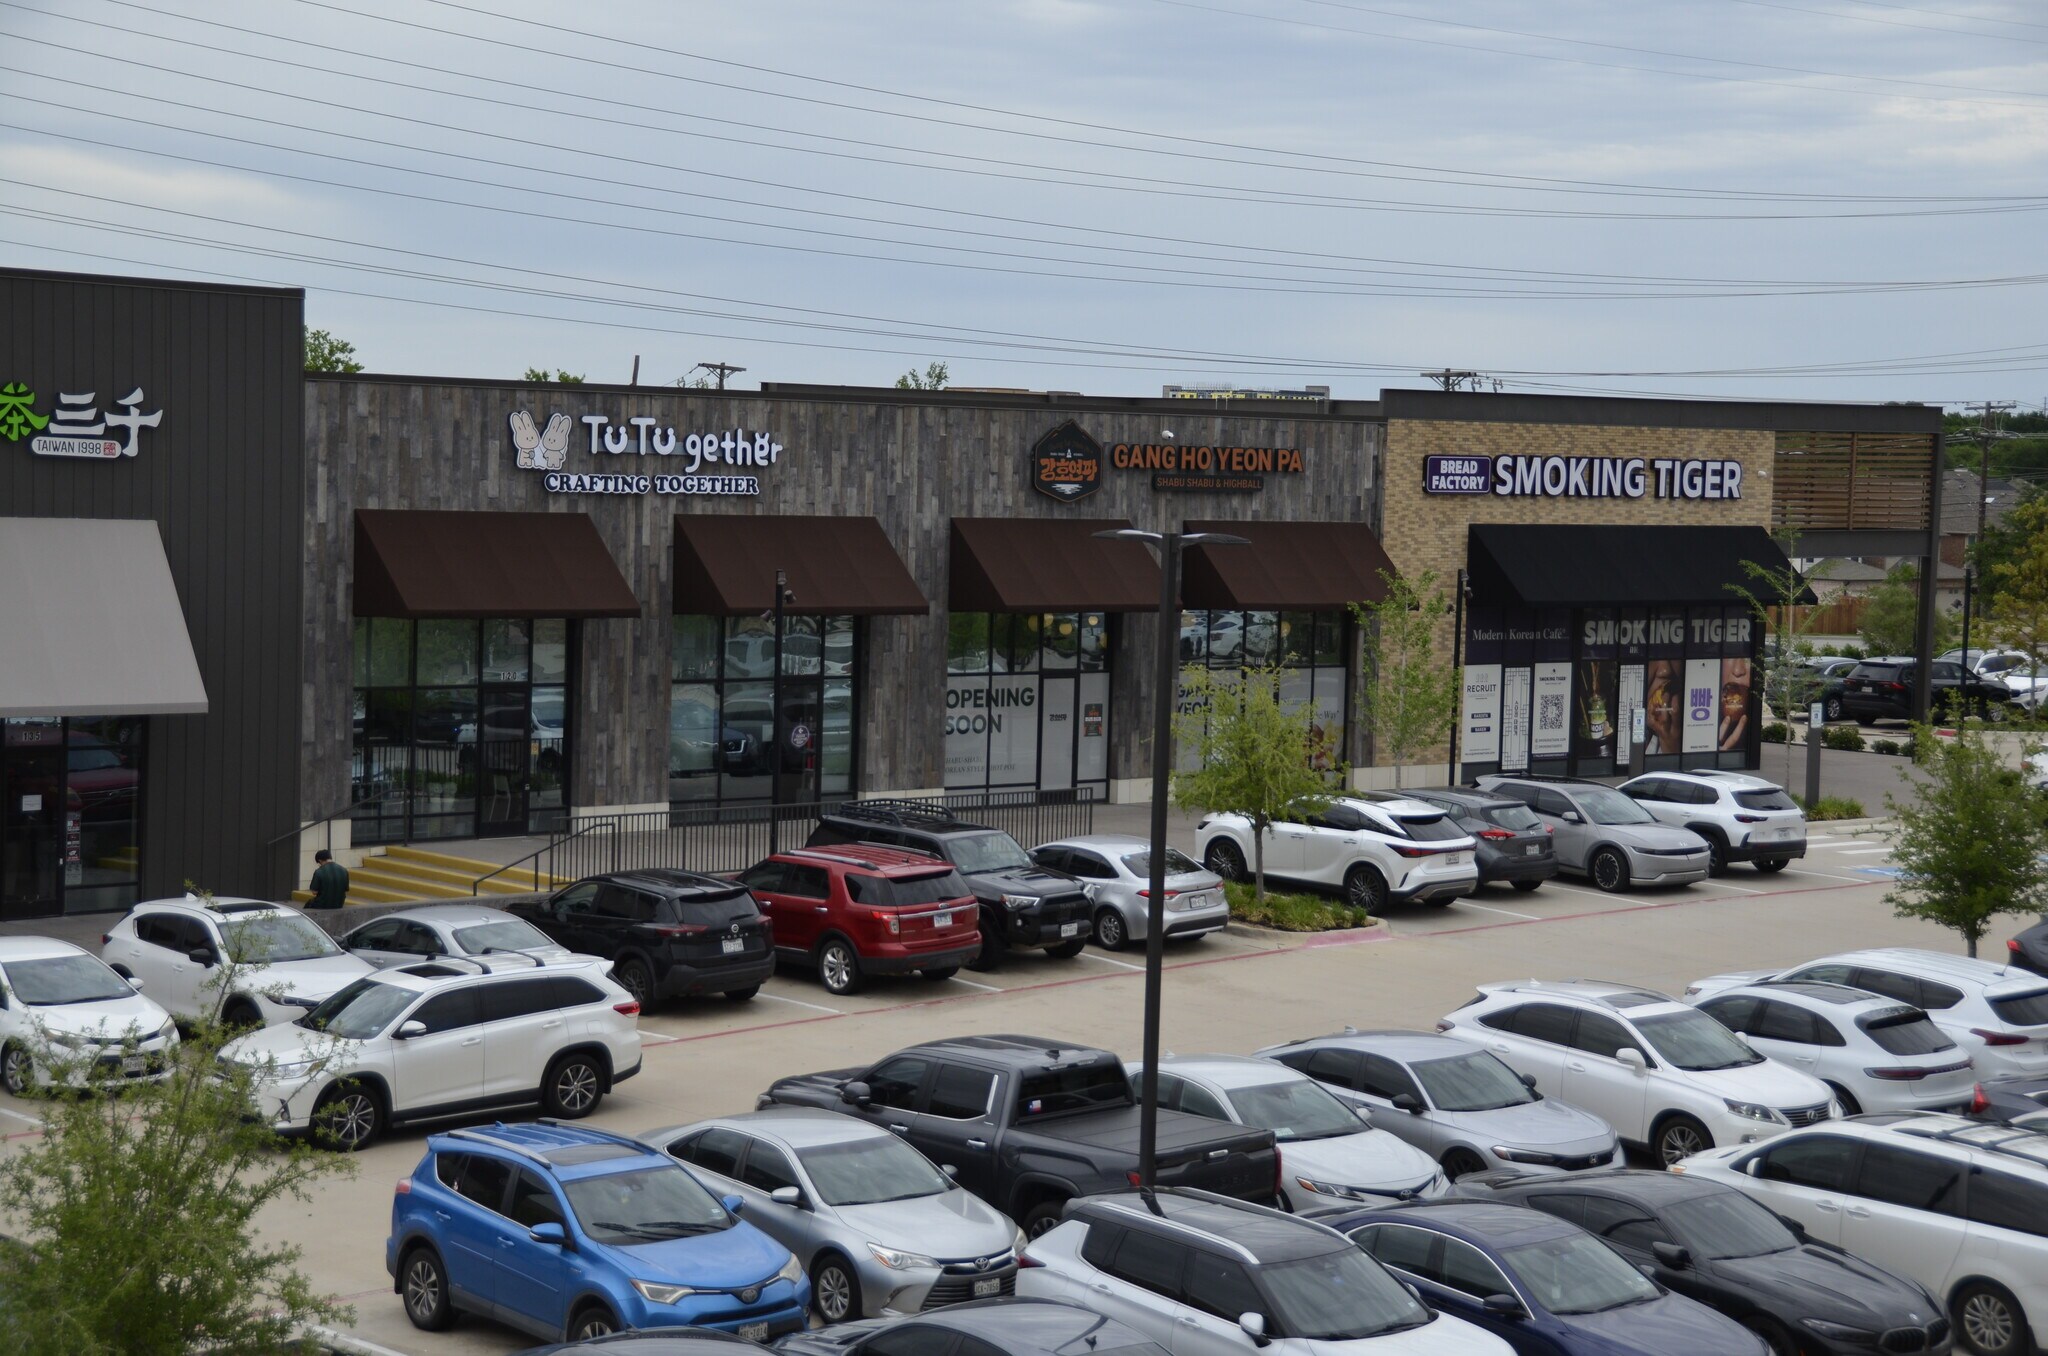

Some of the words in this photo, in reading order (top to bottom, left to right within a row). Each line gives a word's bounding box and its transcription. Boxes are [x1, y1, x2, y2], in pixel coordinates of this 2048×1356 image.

[36, 439, 75, 454] TAIWAN
[78, 441, 101, 455] 1998
[685, 428, 783, 472] gether
[1113, 443, 1176, 470] GANG
[1181, 446, 1212, 471] HO
[1217, 447, 1272, 472] YEON
[1278, 449, 1304, 473] PA
[1440, 460, 1478, 474] BREAD
[1039, 457, 1098, 482] 강호연파
[1495, 455, 1646, 497] SMOKING
[1653, 459, 1743, 499] TIGER
[546, 473, 650, 493] CRAFTING
[656, 475, 759, 494] TOGETHER
[1156, 477, 1187, 487] SHABU
[1187, 477, 1214, 488] SHABU
[1215, 478, 1222, 488] &
[1223, 478, 1262, 489] HIGHBALL
[1431, 475, 1485, 490] FACTORY
[1509, 628, 1541, 640] Korean
[1584, 619, 1685, 646] SMOKING
[1691, 618, 1750, 643] TIGER
[501, 672, 517, 681] 120
[1466, 683, 1497, 693] RECRUIT
[946, 687, 1035, 709] OPENING
[1690, 687, 1713, 722] 빵
[945, 714, 1002, 735] SOON
[23, 731, 41, 741] 135
[945, 766, 966, 774] OREAN
